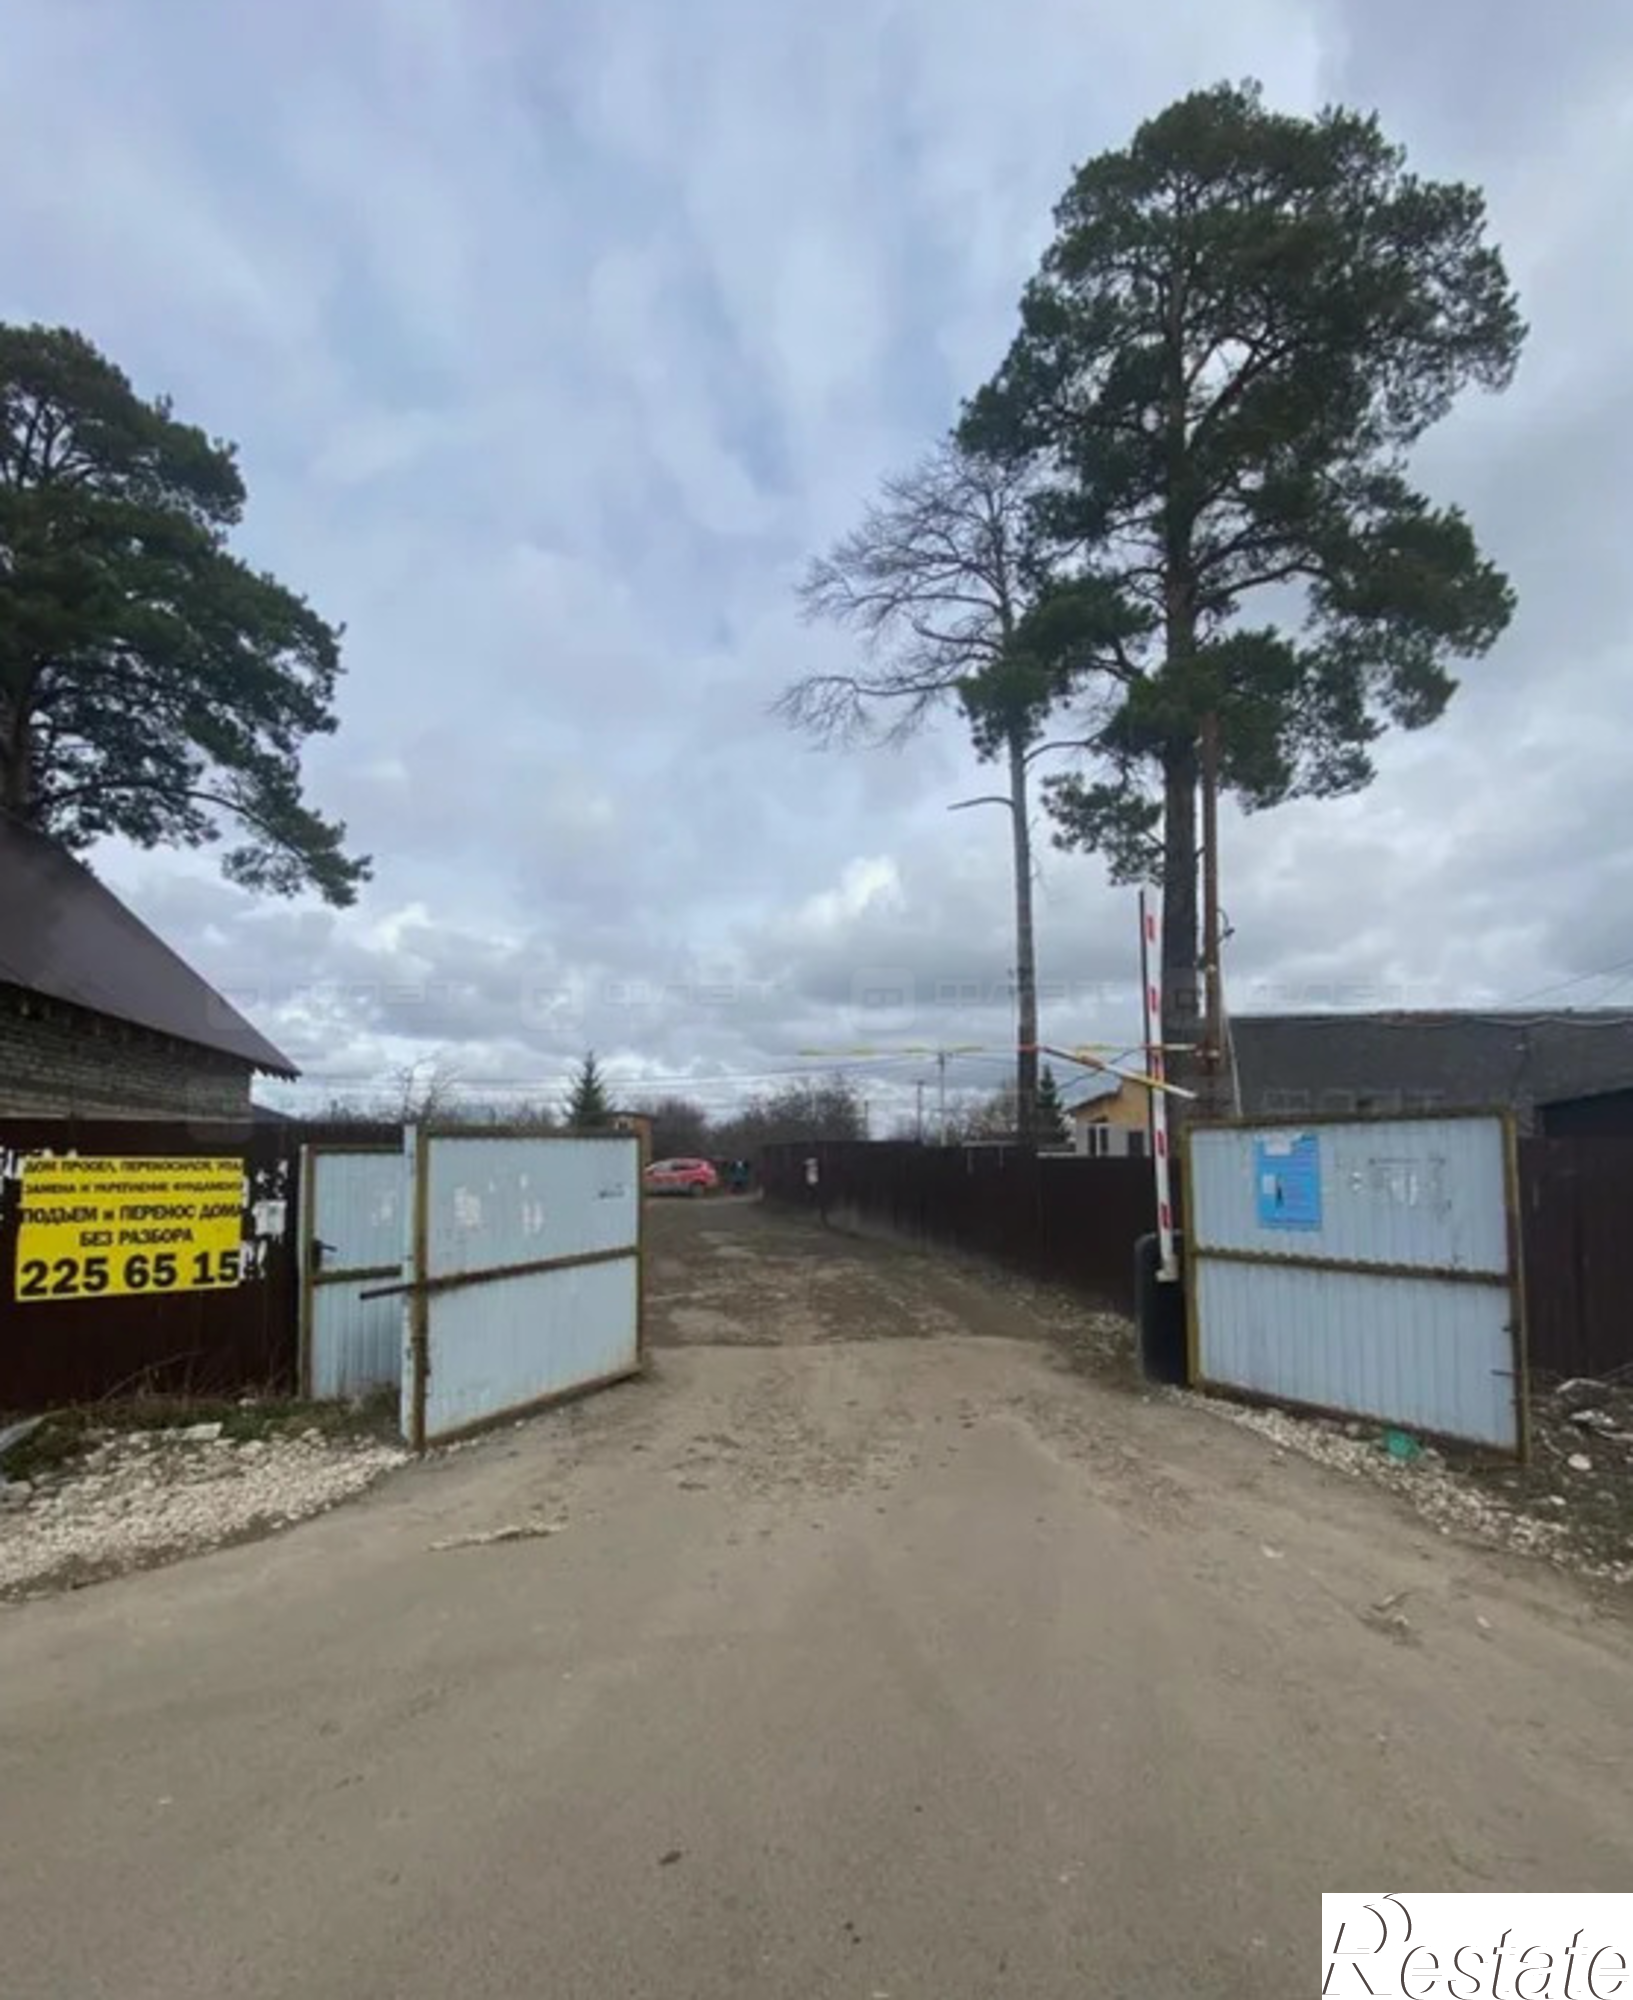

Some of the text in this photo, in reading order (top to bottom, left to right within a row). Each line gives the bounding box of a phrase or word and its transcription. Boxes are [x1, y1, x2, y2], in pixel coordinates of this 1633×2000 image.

[24, 1160, 58, 1174] ДОМ
[26, 1183, 77, 1195] ЗАМЕНА
[120, 1204, 196, 1221] ПЕРЕНОС
[80, 1228, 194, 1247] БЕЗ РАЗБОРА
[20, 1251, 241, 1297] 225 65 15
